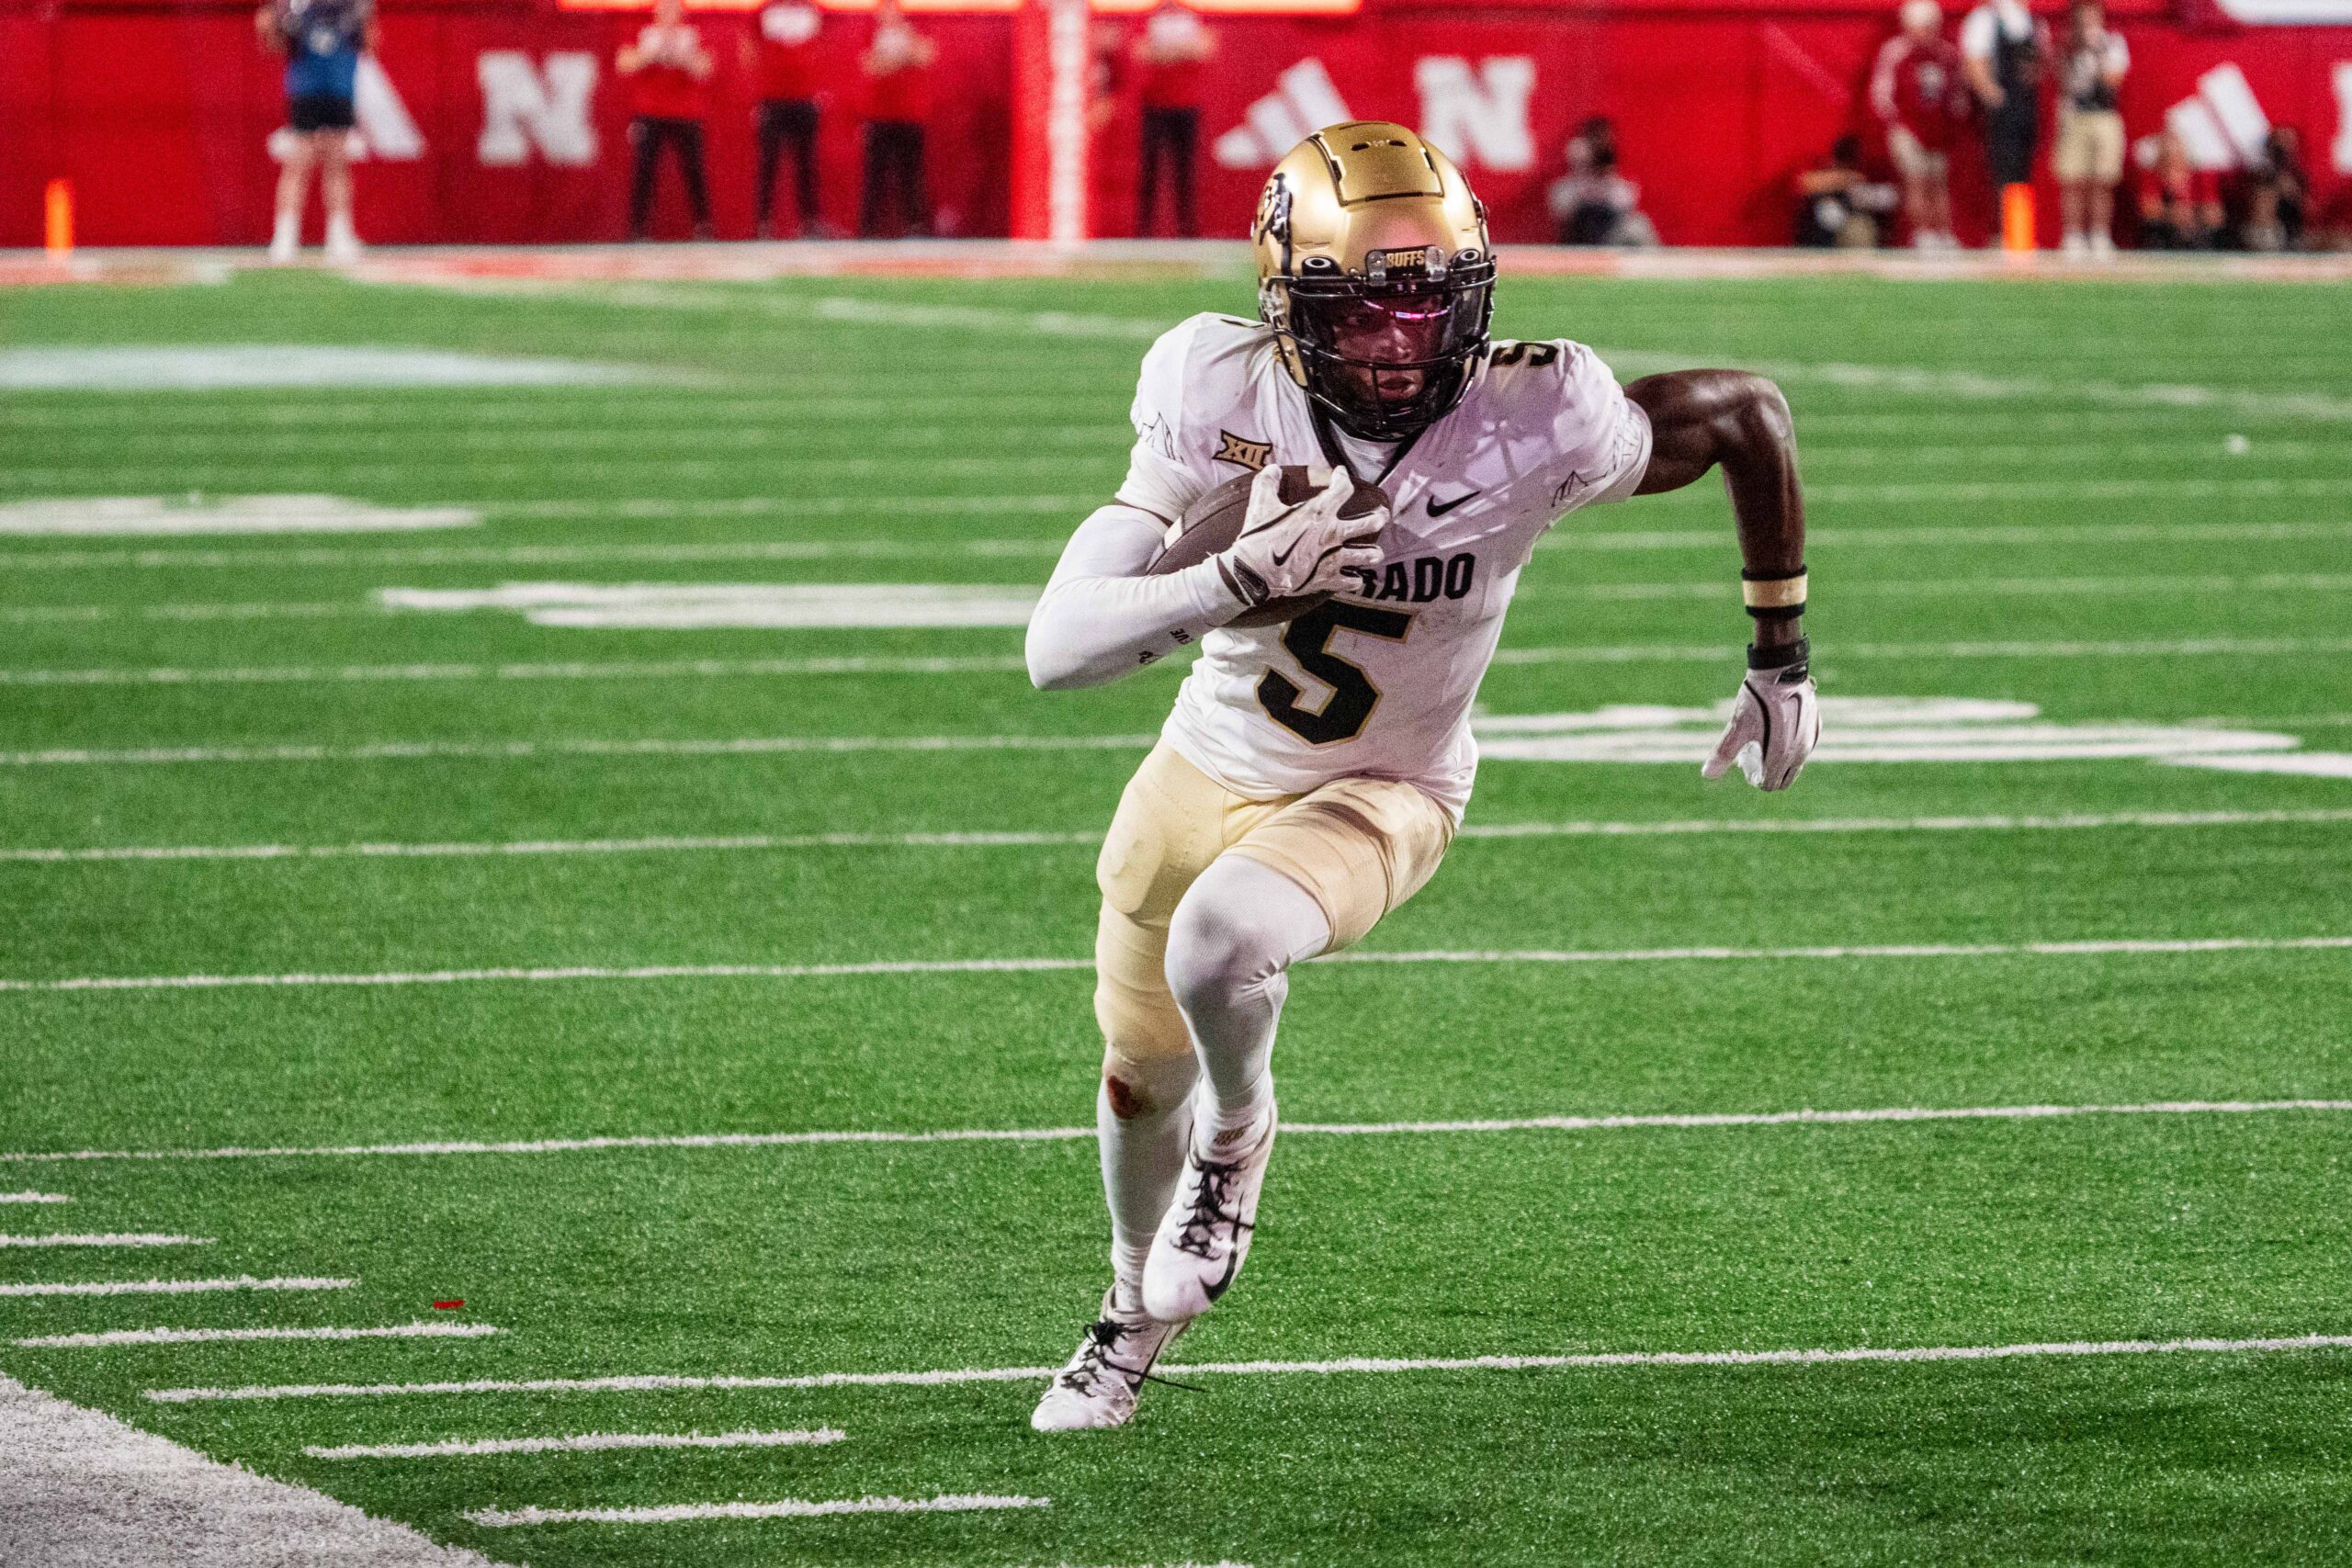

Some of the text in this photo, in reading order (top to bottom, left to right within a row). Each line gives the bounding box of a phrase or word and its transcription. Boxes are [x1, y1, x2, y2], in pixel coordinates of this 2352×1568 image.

[477, 51, 599, 166] N
[1414, 55, 1537, 169] N
[1385, 250, 1425, 268] BUFFS
[1360, 552, 1476, 603] RADO
[1254, 598, 1421, 750] 5
